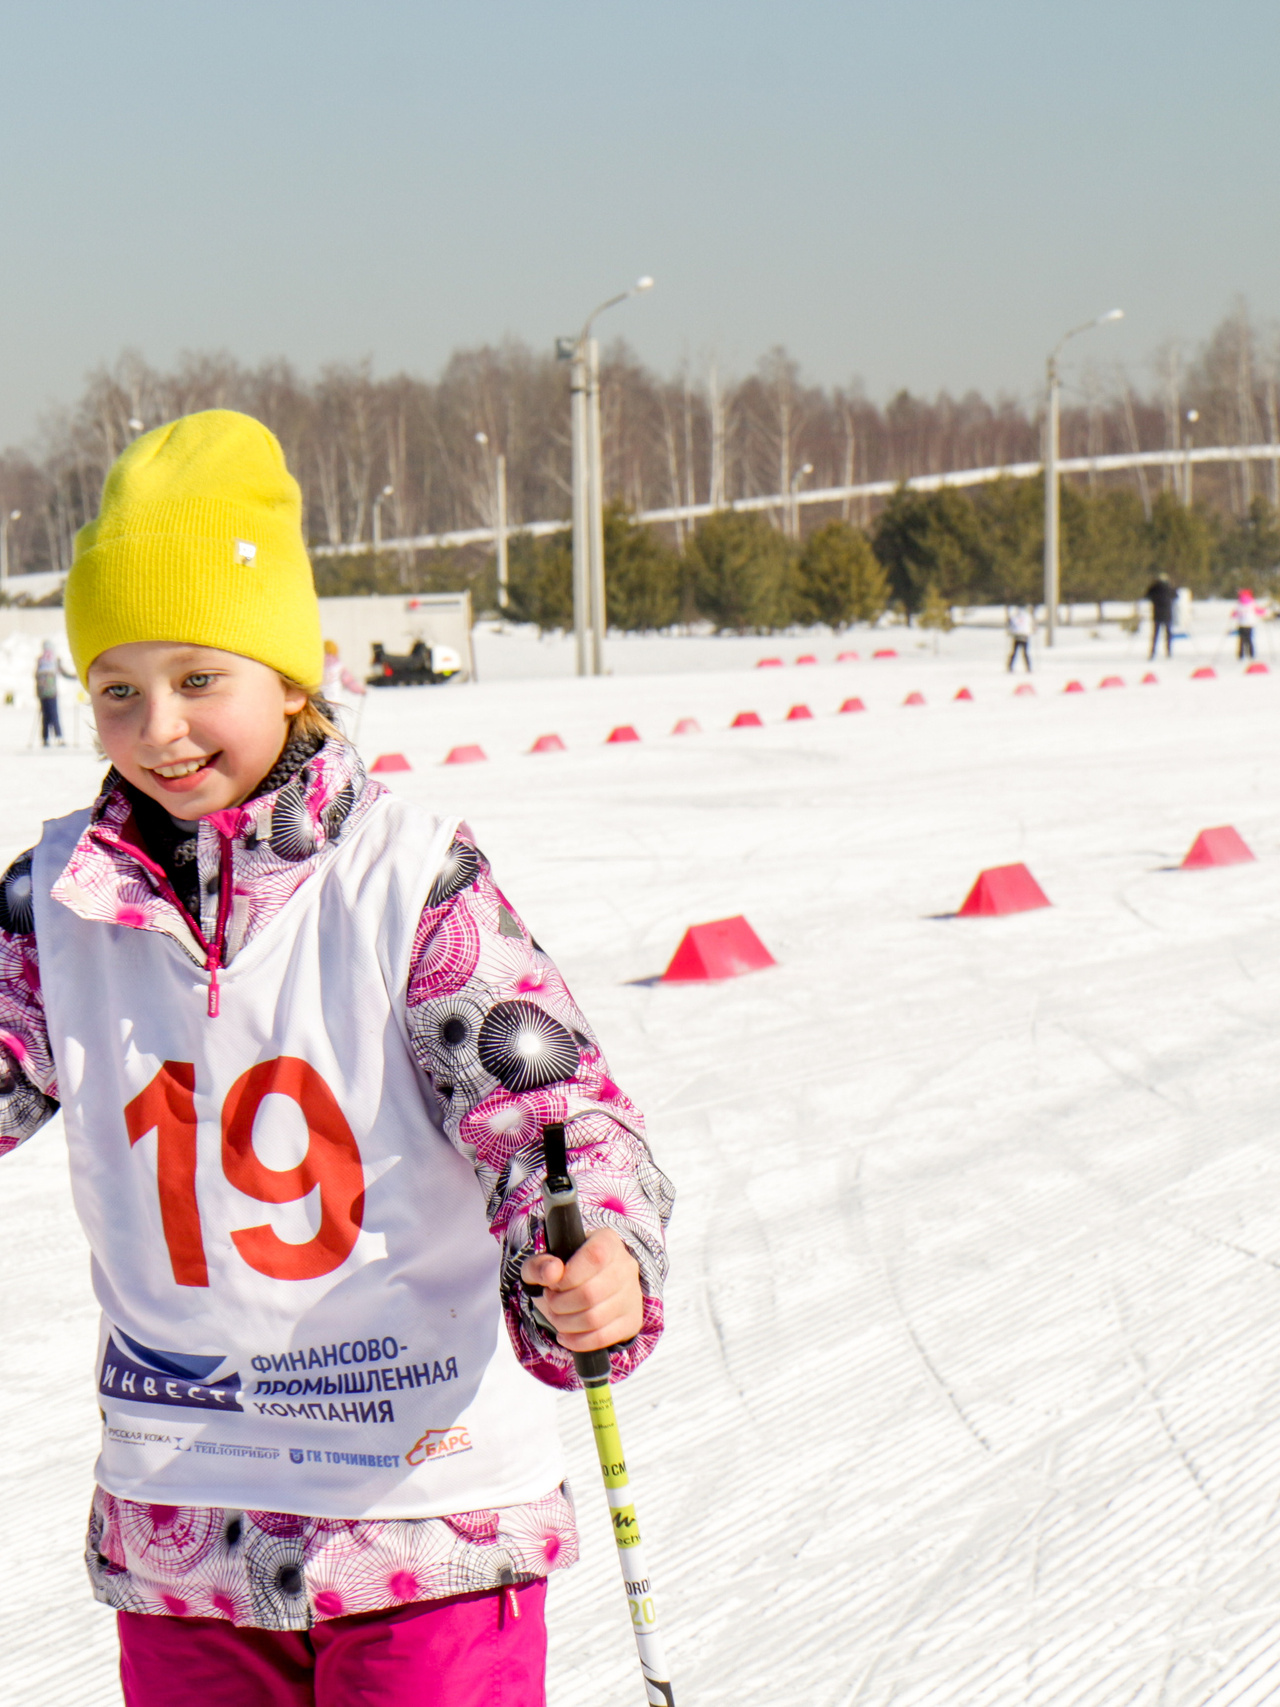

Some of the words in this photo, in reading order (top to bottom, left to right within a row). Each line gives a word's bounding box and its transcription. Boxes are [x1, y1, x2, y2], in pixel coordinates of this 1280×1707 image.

[124, 1056, 366, 1288] 19
[251, 1336, 408, 1374] ФИНАНСОВО-
[102, 1364, 226, 1404] ИНВЕСТ
[253, 1356, 459, 1396] ПРОМЫШЛЕННАЯ
[253, 1399, 395, 1424] КОМПАНИЯ
[194, 1444, 281, 1460] ТЕПЛОПРИБОР
[306, 1450, 322, 1463] ГК
[325, 1451, 400, 1468] ТОЧИНВЕСТ
[425, 1432, 472, 1457] БАРС
